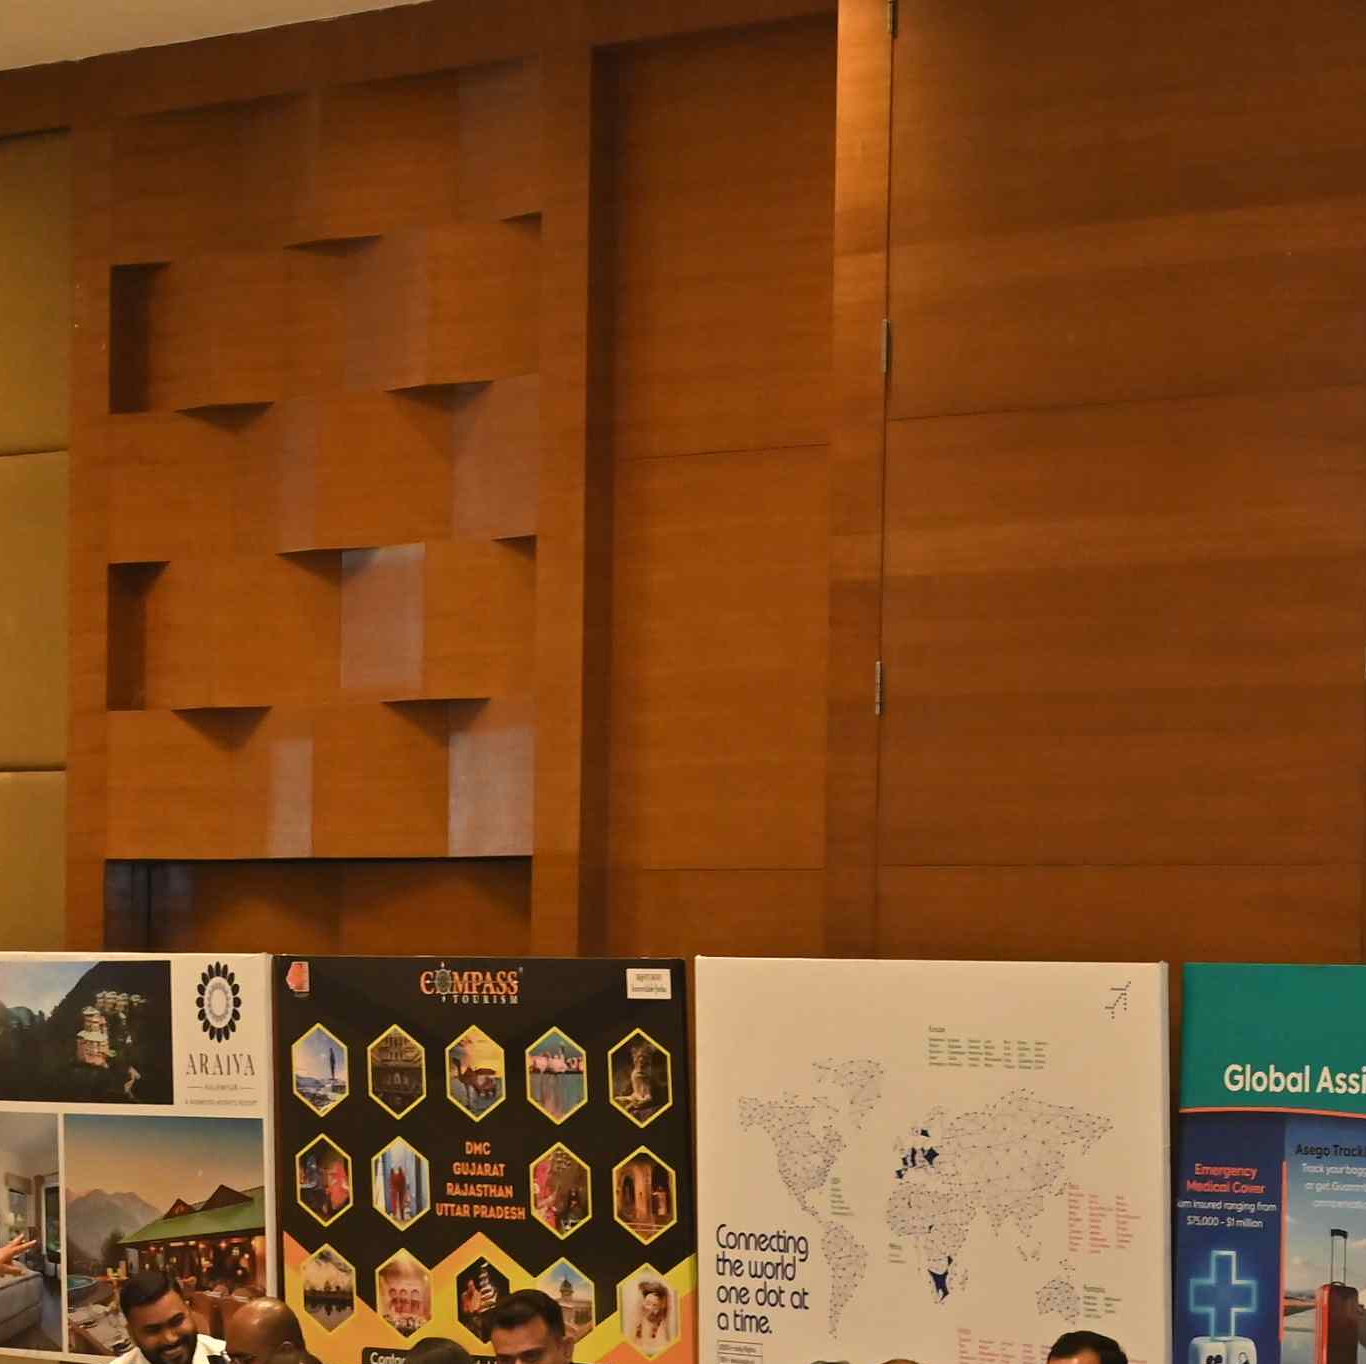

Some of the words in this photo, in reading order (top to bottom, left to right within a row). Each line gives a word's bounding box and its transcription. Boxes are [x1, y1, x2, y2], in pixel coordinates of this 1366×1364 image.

[419, 968, 519, 995] COMPASS
[452, 994, 519, 1005] TOURISM
[186, 1052, 256, 1076] ARAIYA
[1223, 1063, 1311, 1093] Global
[464, 1140, 492, 1156] DMC
[1295, 1144, 1331, 1159] Asego
[452, 1161, 506, 1177] GUJARAT
[1194, 1162, 1259, 1180] Emergency
[1301, 1162, 1323, 1173] Track
[1325, 1165, 1345, 1176] your
[446, 1182, 514, 1199] RAJASTHAN
[1186, 1179, 1231, 1193] Medical
[1233, 1181, 1267, 1194] Cover
[435, 1202, 471, 1218] UTTAR
[472, 1204, 526, 1221] PRADESH
[1193, 1199, 1223, 1210] insured
[1223, 1201, 1256, 1214] ranging
[1256, 1201, 1277, 1212] from
[1235, 1218, 1264, 1229] million
[716, 1223, 809, 1263] Connecting
[716, 1250, 745, 1278] the
[748, 1254, 797, 1282] world
[716, 1284, 751, 1305] one
[755, 1280, 786, 1309] dot
[790, 1287, 810, 1311] at
[717, 1311, 729, 1331] a
[732, 1308, 773, 1335] time.
